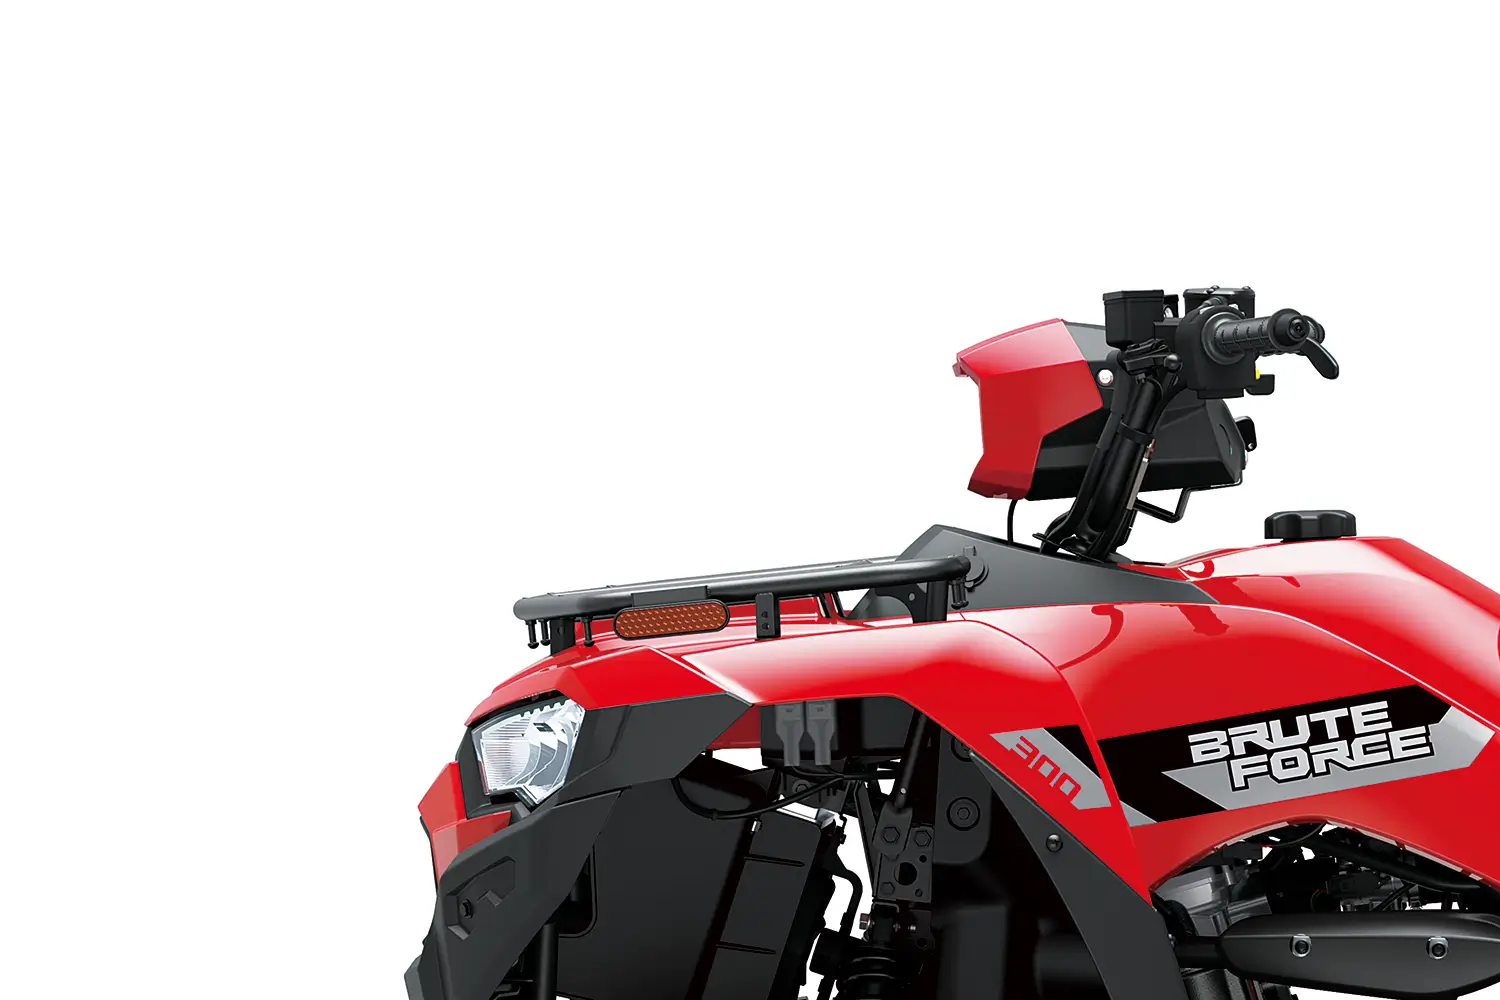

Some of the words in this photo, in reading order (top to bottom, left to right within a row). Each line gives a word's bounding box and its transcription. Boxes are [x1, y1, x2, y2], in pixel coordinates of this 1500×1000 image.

[1188, 700, 1392, 764] BRUTE
[1229, 724, 1431, 790] FORCE
[1008, 735, 1082, 808] 300
